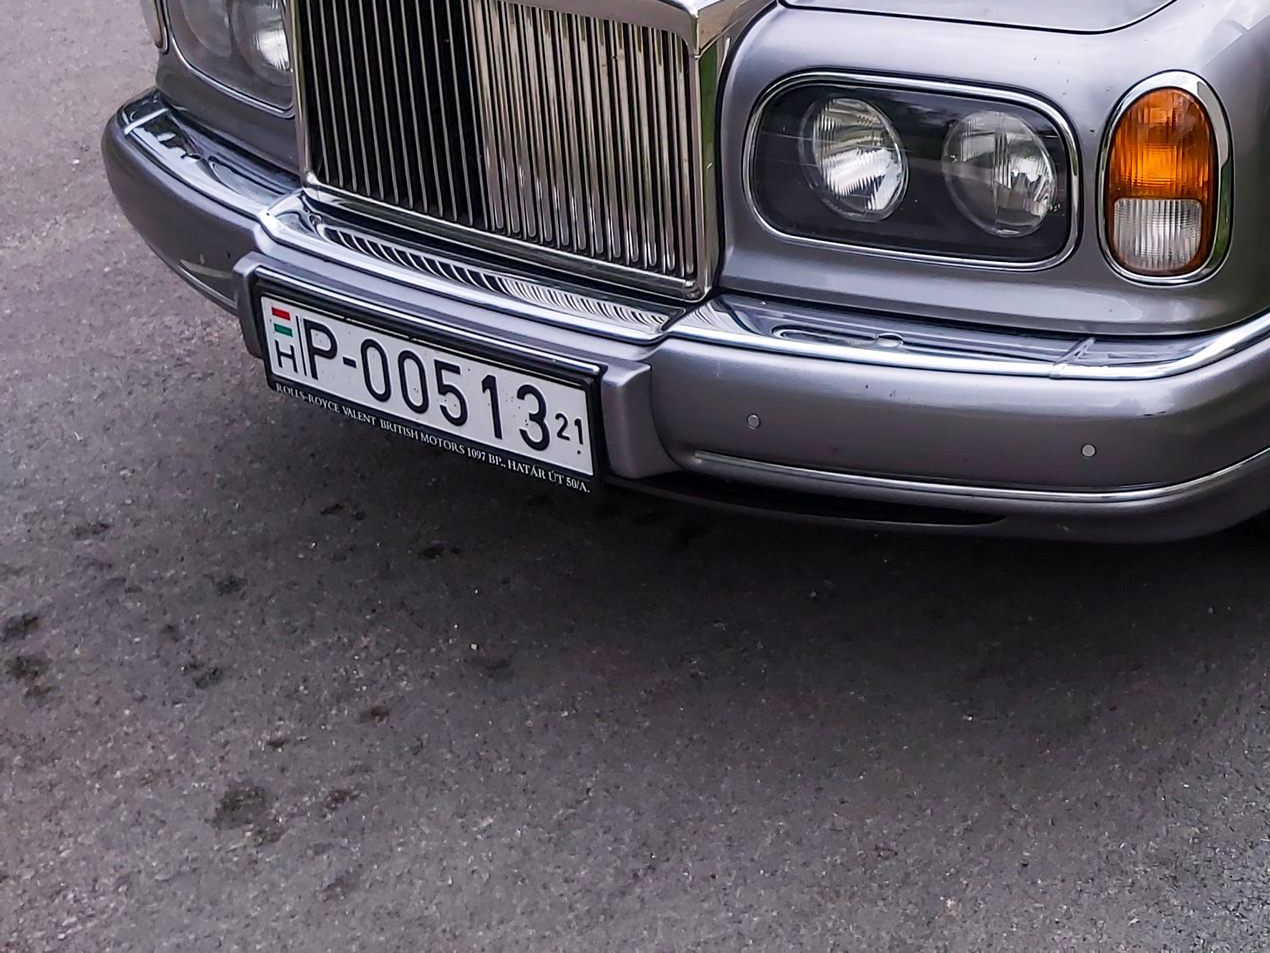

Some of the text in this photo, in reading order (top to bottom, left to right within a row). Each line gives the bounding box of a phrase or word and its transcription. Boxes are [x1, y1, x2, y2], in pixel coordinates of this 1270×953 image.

[274, 339, 298, 374] H
[303, 317, 584, 452] P-00513 21
[275, 382, 340, 413] ROLLS-ROYCE
[342, 405, 376, 426] VALENT
[380, 418, 419, 440] BRITISH
[420, 432, 465, 455] MOTORS
[467, 447, 486, 462] 1097
[507, 458, 546, 480] HATÁR
[548, 470, 564, 485] ÚT
[566, 476, 591, 493] 50/A.
